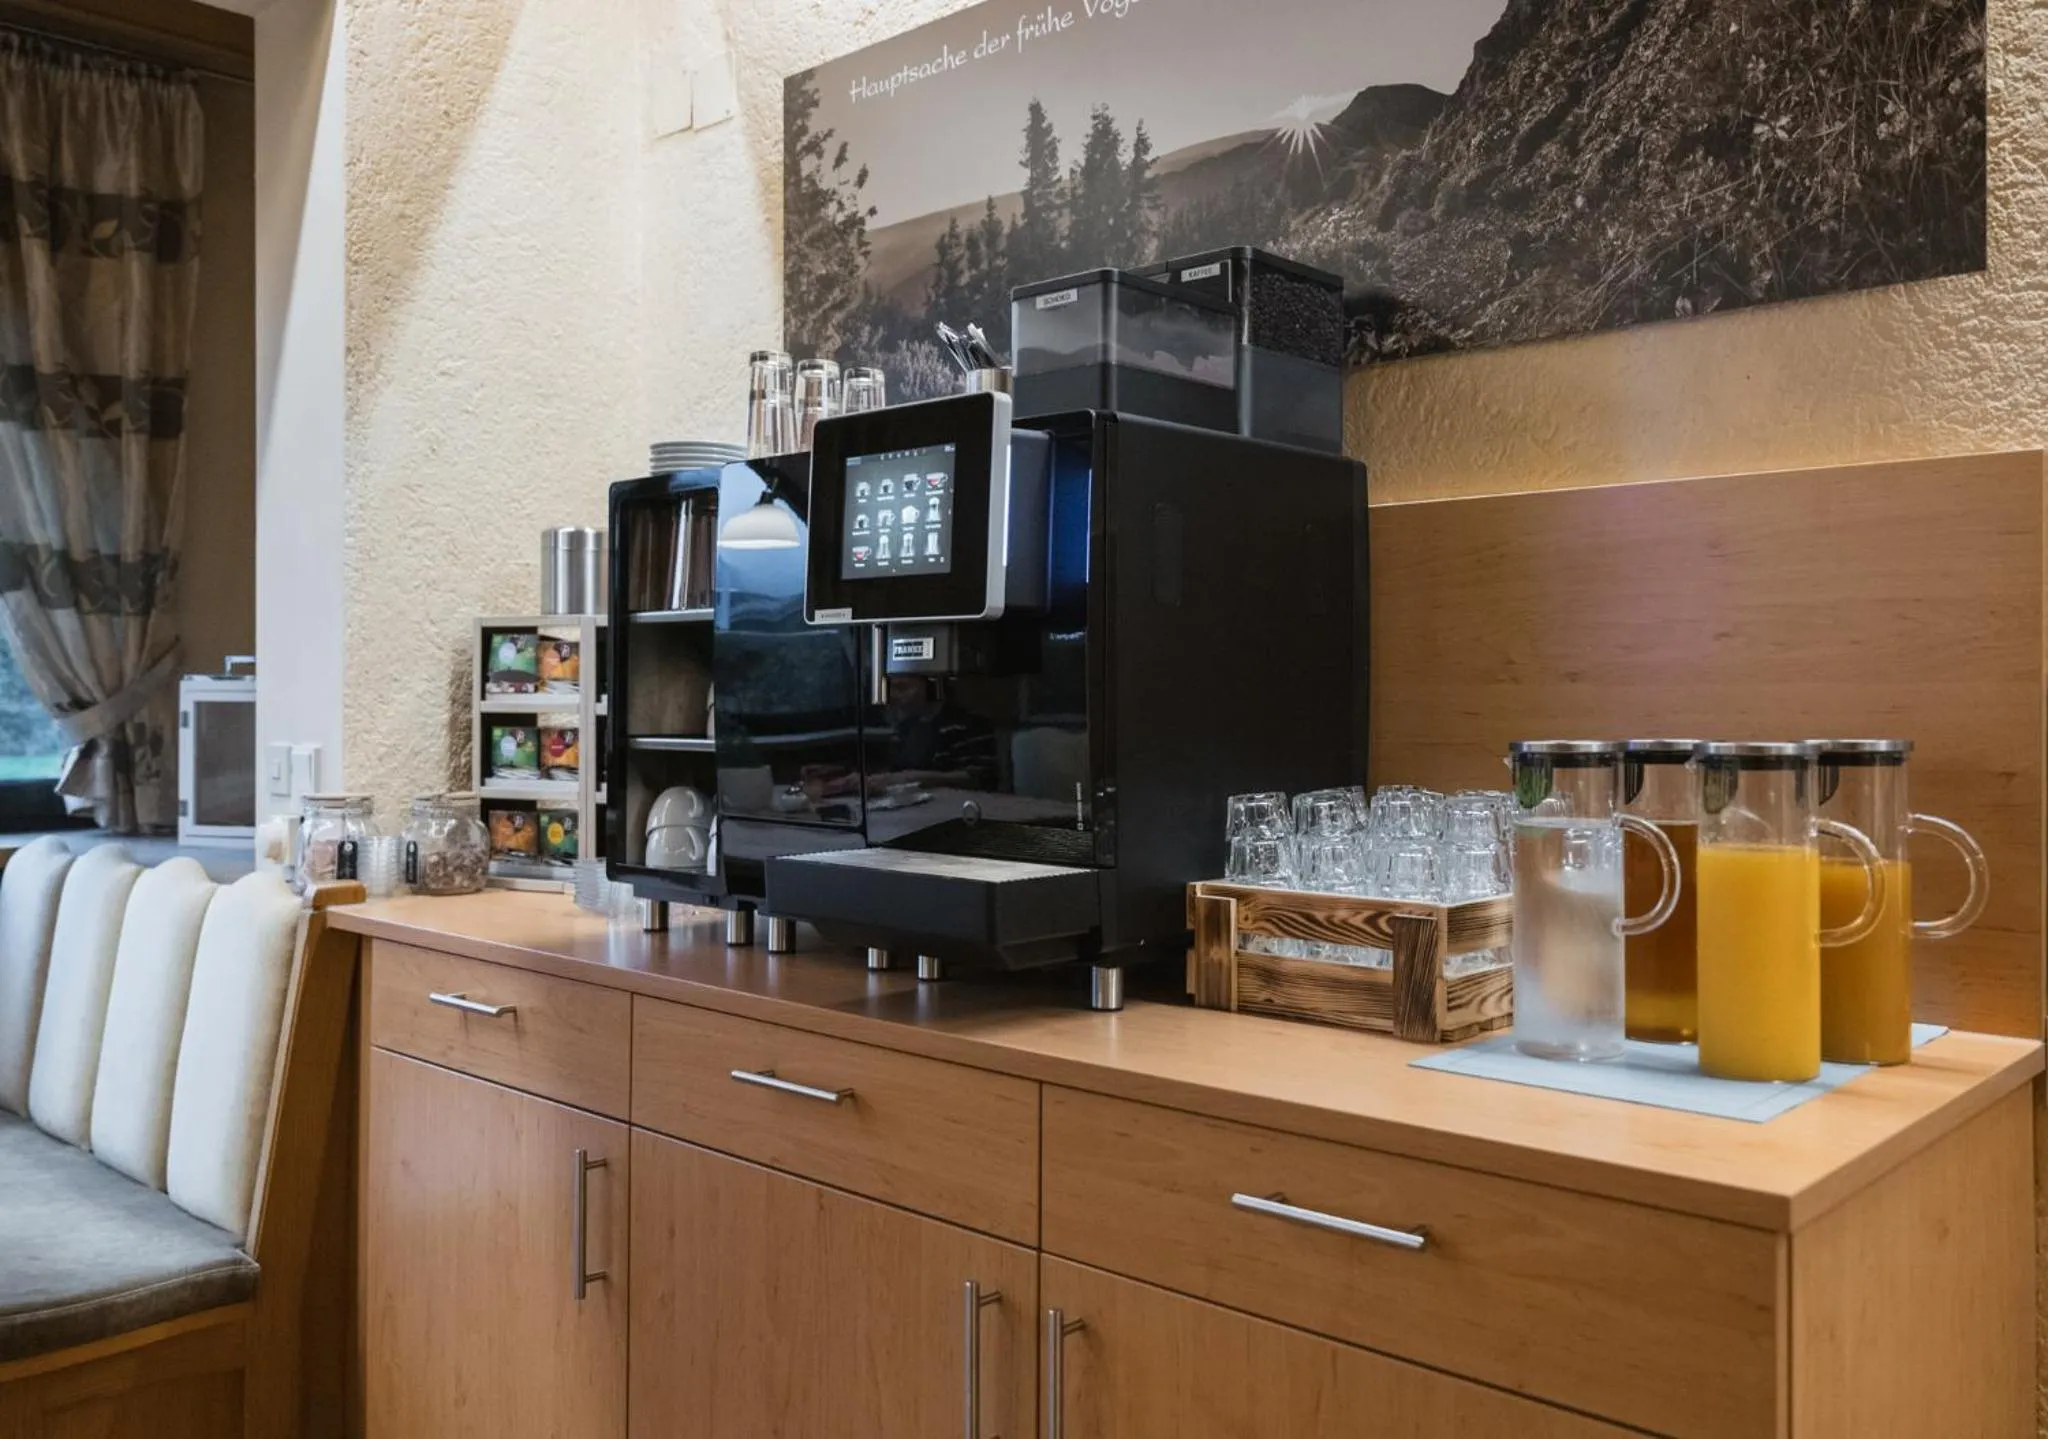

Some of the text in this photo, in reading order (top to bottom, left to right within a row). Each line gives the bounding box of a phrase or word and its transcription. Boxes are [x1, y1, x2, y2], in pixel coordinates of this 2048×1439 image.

[849, 44, 968, 103] Hauptsache
[973, 31, 1010, 60] der
[1016, 5, 1074, 53] frühe
